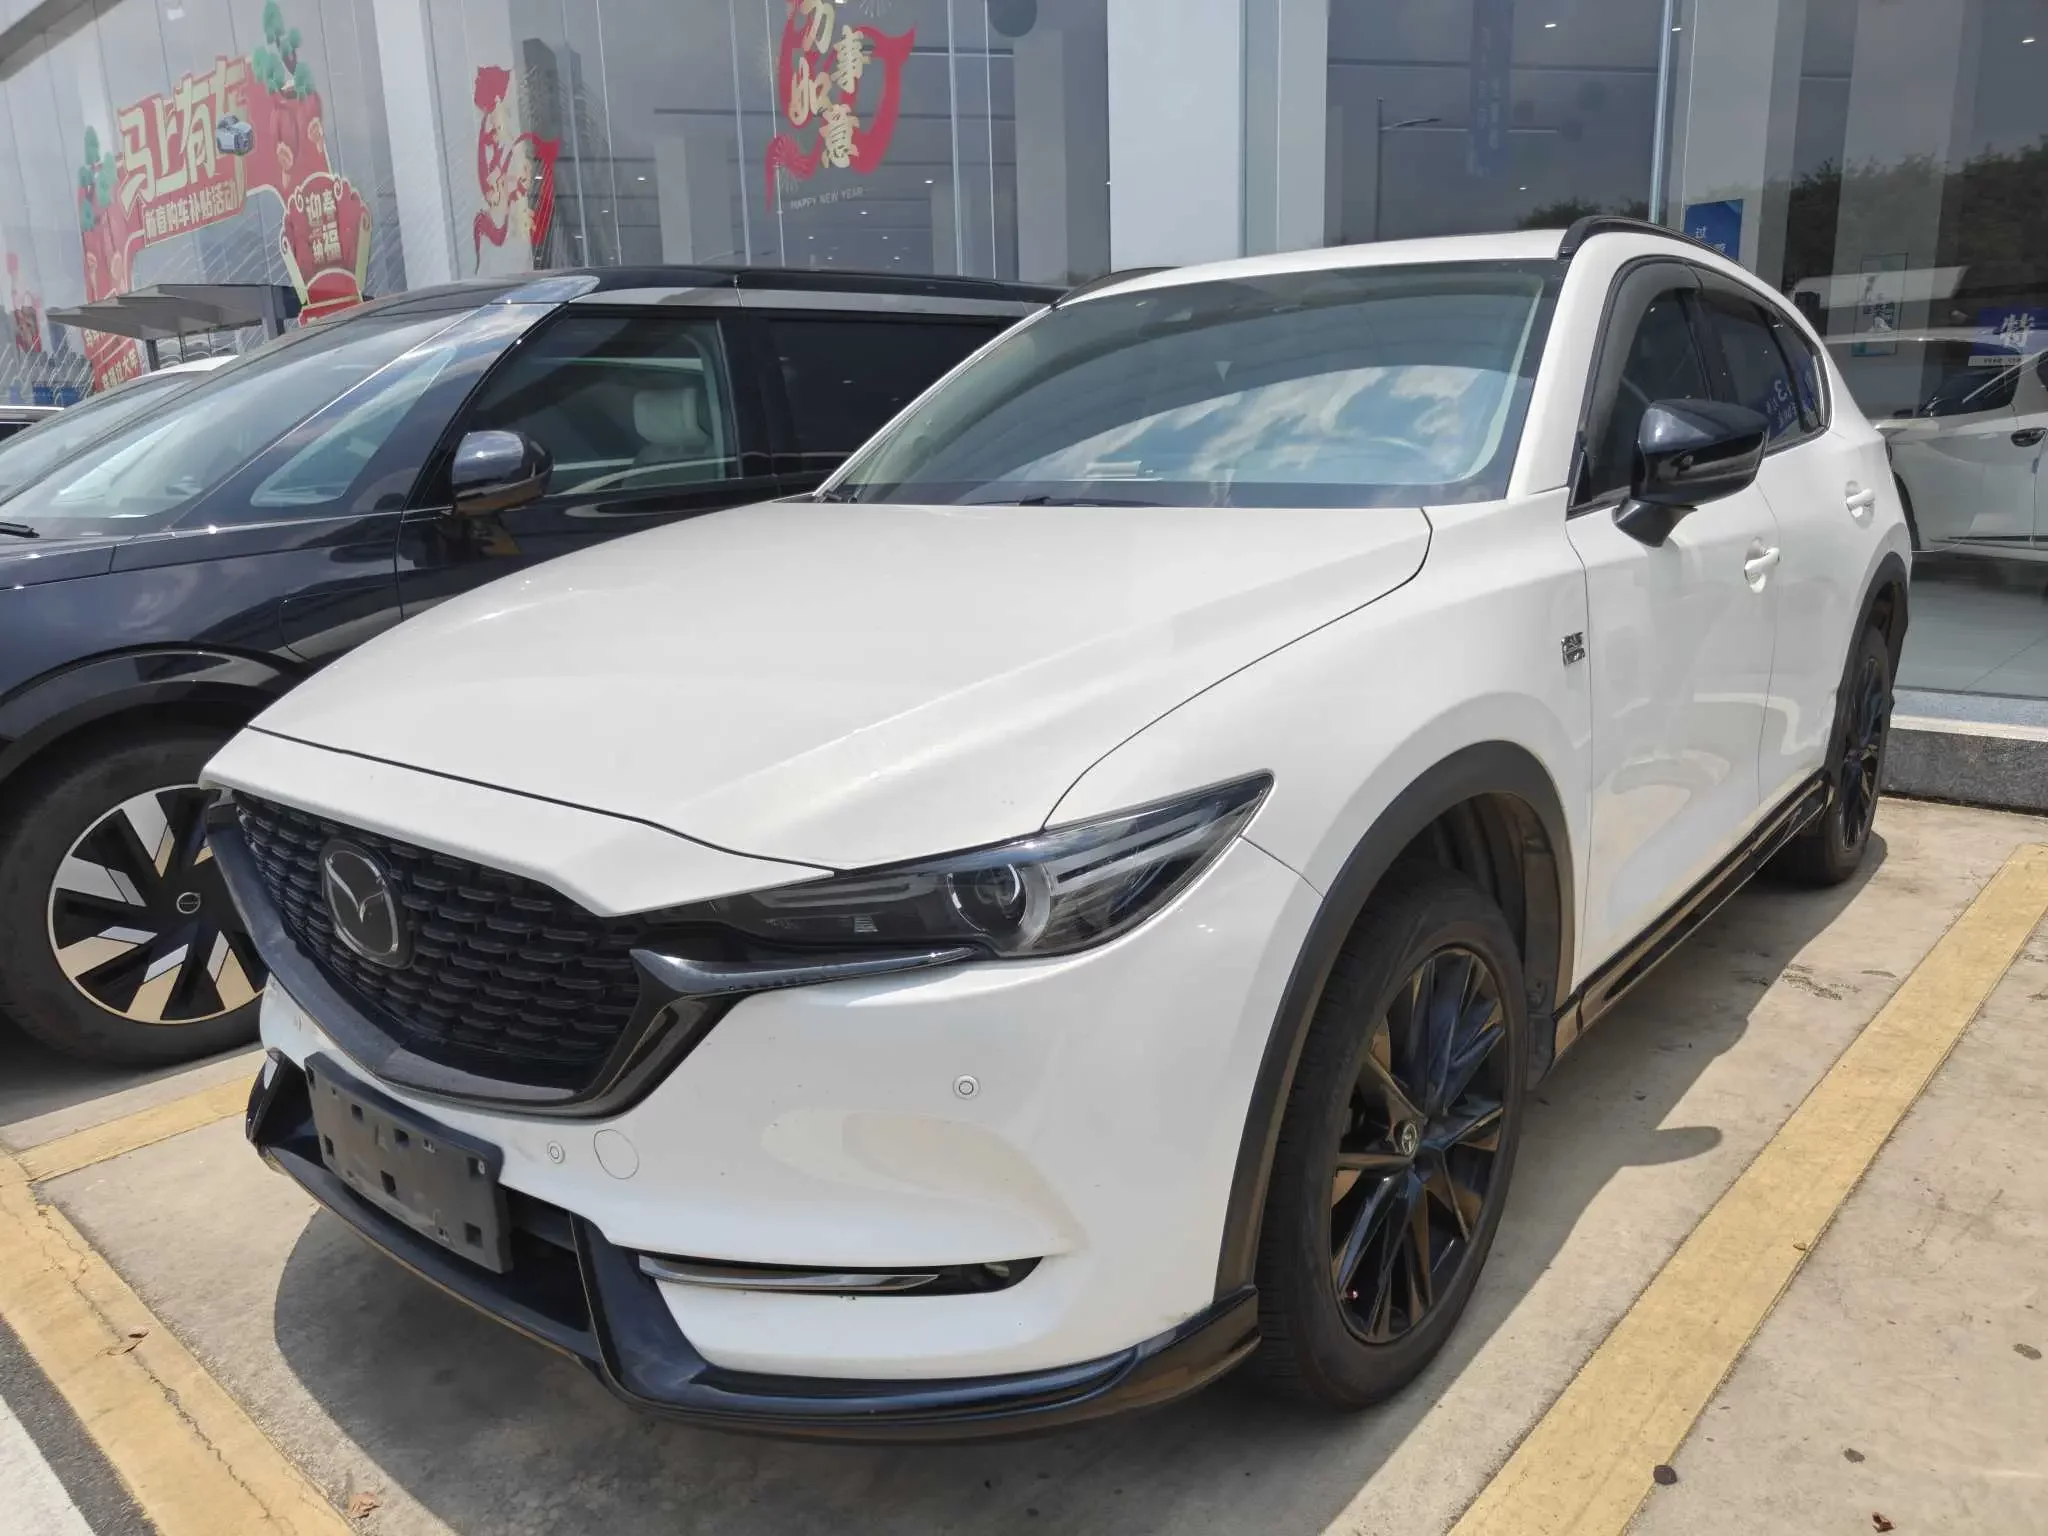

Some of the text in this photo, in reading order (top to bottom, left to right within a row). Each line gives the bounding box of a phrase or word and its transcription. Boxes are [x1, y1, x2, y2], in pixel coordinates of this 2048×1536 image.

[790, 186, 864, 210] HAPPY NEW YEAR
